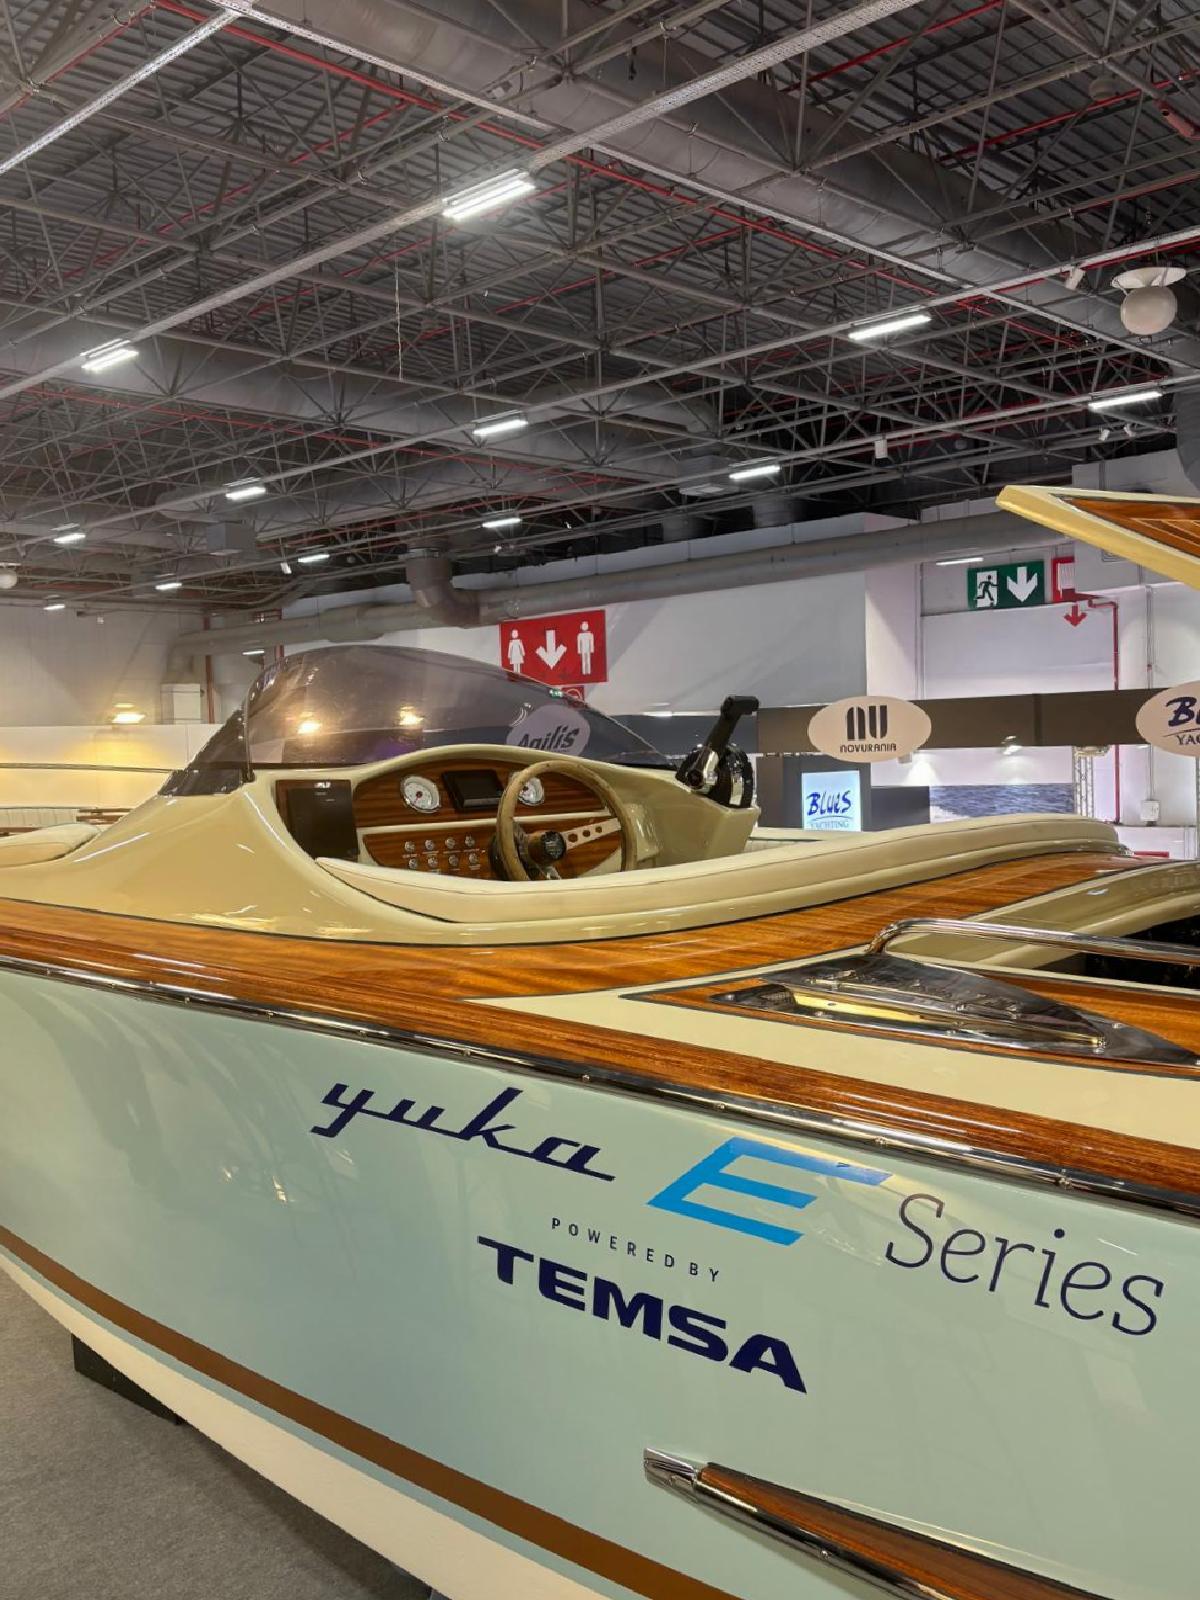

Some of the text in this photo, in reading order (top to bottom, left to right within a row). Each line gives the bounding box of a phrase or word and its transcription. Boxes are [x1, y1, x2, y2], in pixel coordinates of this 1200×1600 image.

[840, 743, 897, 753] NOVURANIA
[310, 1083, 1164, 1335] yuka E Series
[551, 1217, 719, 1282] POWERED BY
[476, 1235, 807, 1394] TEMSA
